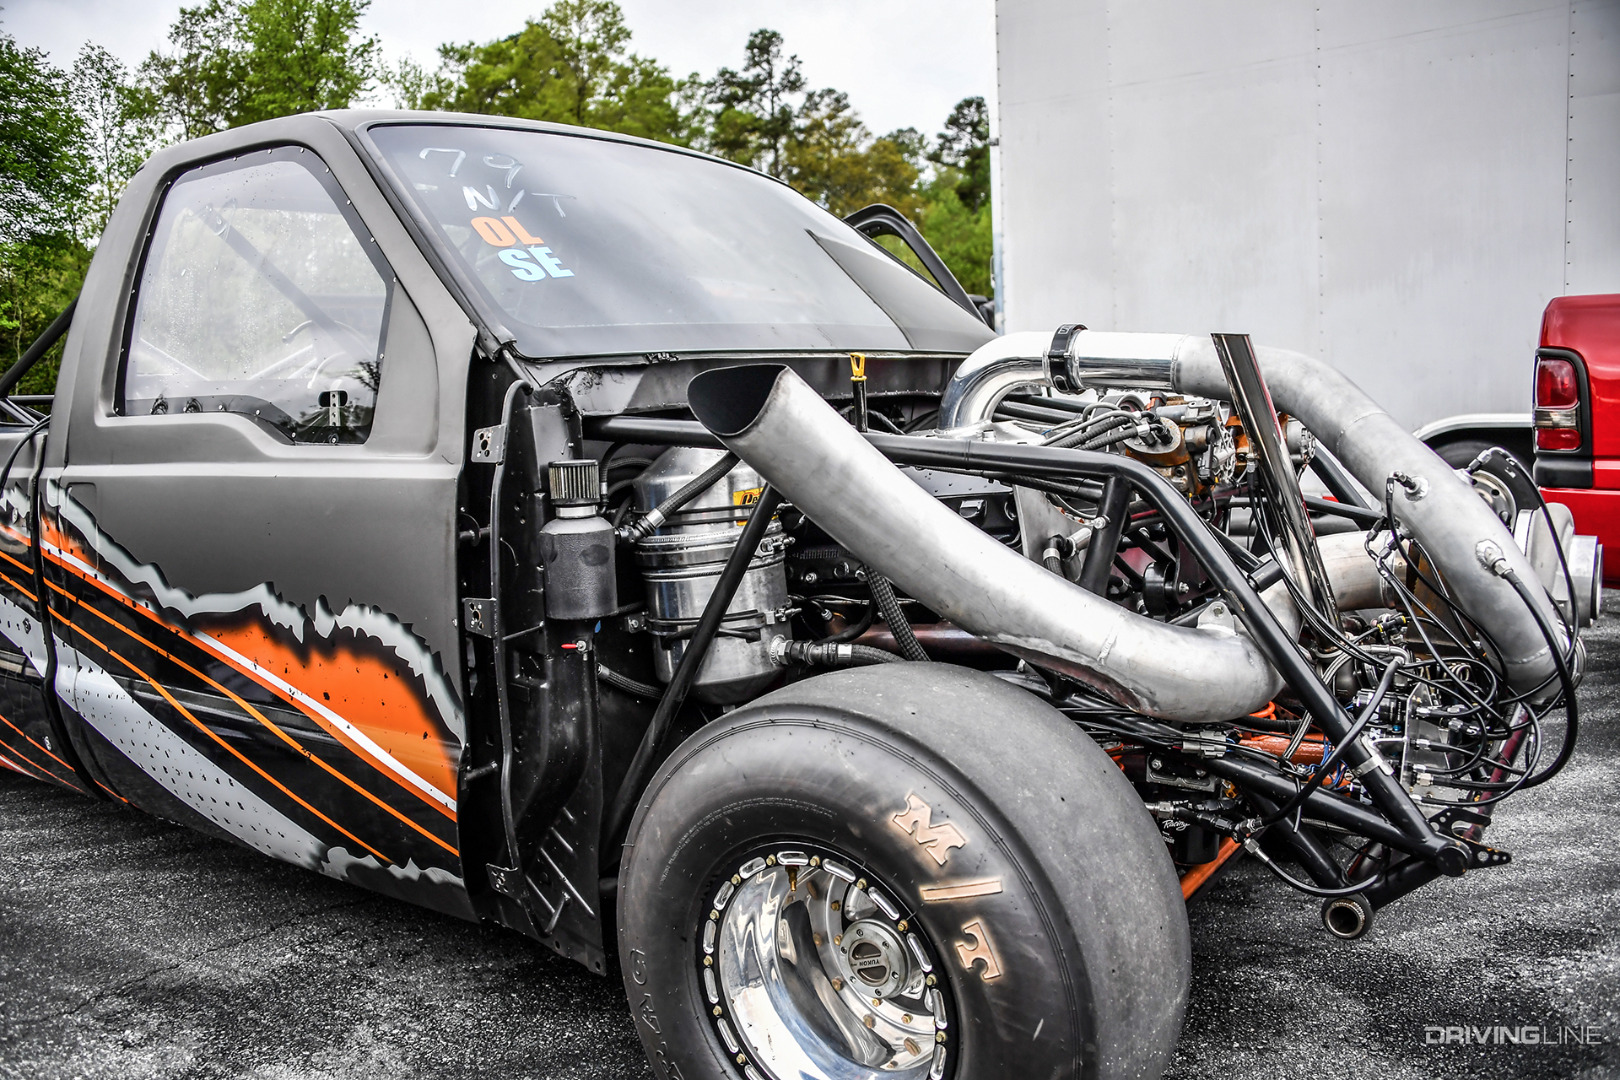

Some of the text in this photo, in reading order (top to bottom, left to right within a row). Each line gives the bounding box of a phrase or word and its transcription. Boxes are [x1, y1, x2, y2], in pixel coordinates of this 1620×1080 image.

[419, 147, 524, 188] 79
[497, 246, 575, 282] SE
[1162, 819, 1190, 831] Racing
